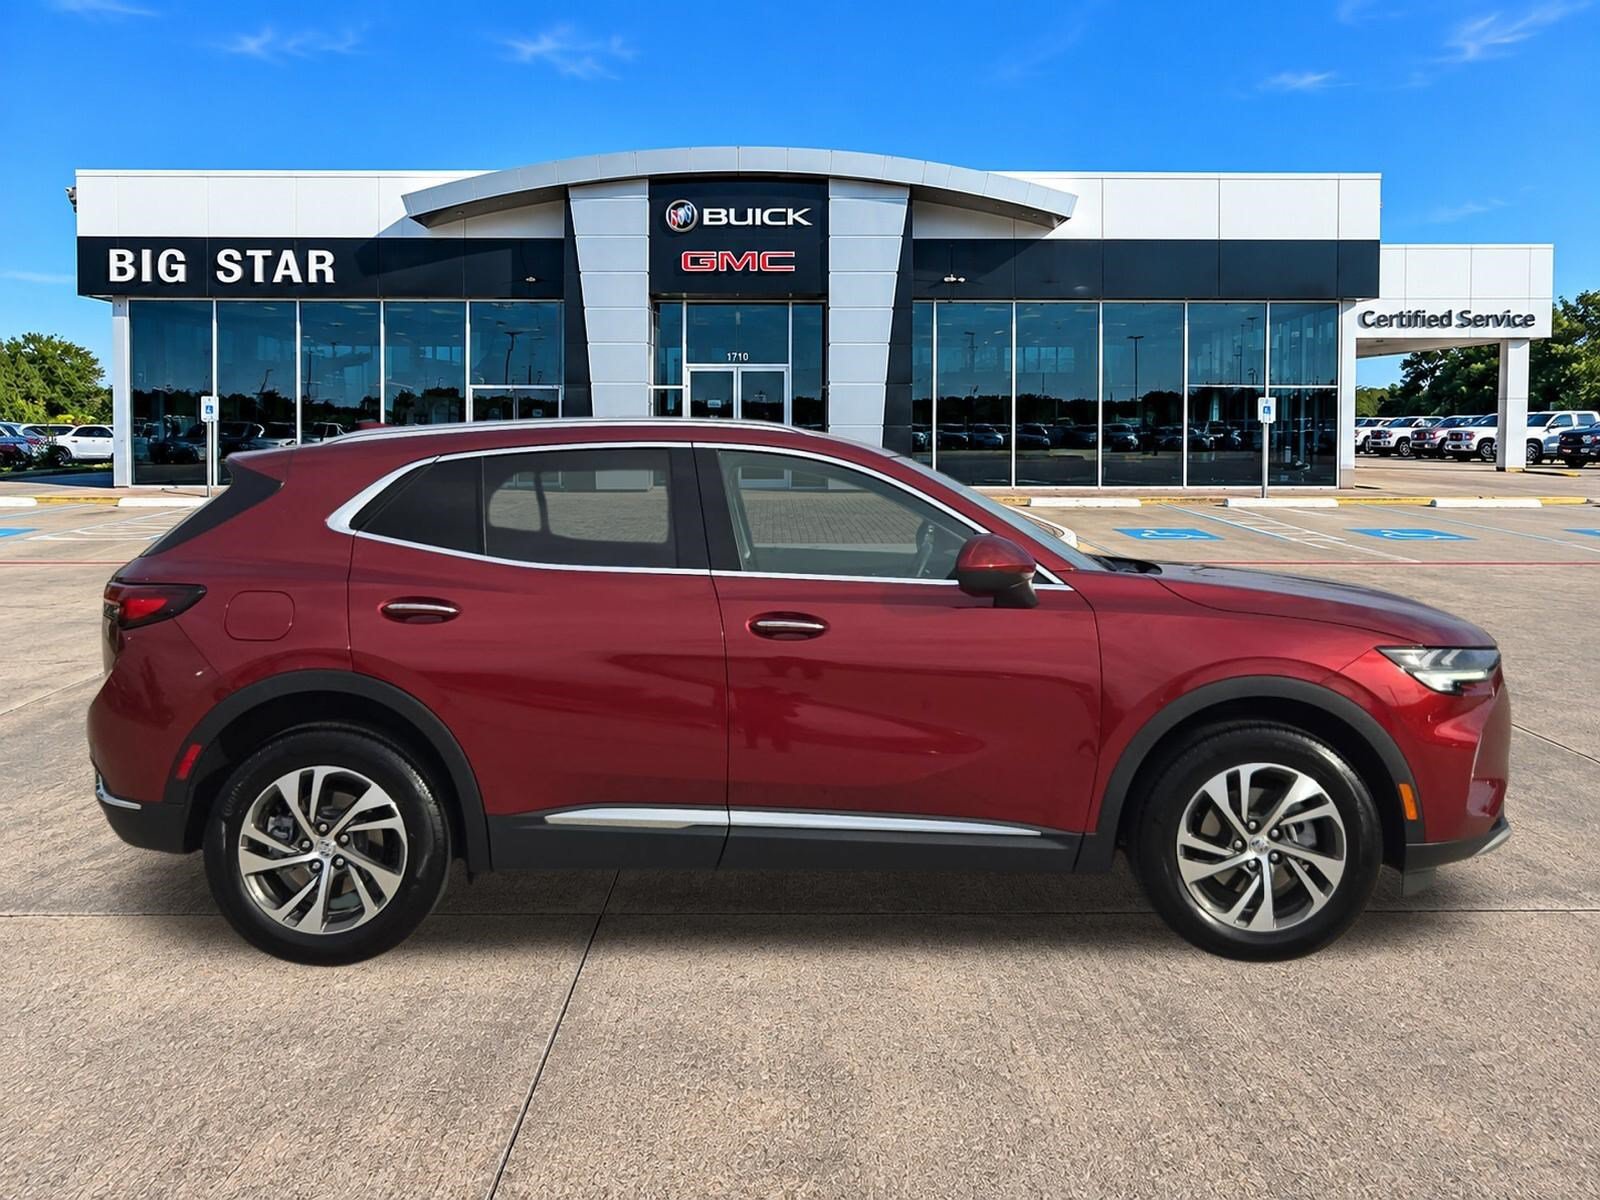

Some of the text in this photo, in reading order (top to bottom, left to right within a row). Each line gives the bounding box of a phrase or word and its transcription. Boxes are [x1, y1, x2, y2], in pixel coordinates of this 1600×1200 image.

[703, 207, 813, 226] BUICK
[108, 248, 336, 284] BIG STAR
[681, 250, 796, 272] GMC
[1360, 309, 1536, 328] Certified Service
[726, 352, 749, 361] 1710
